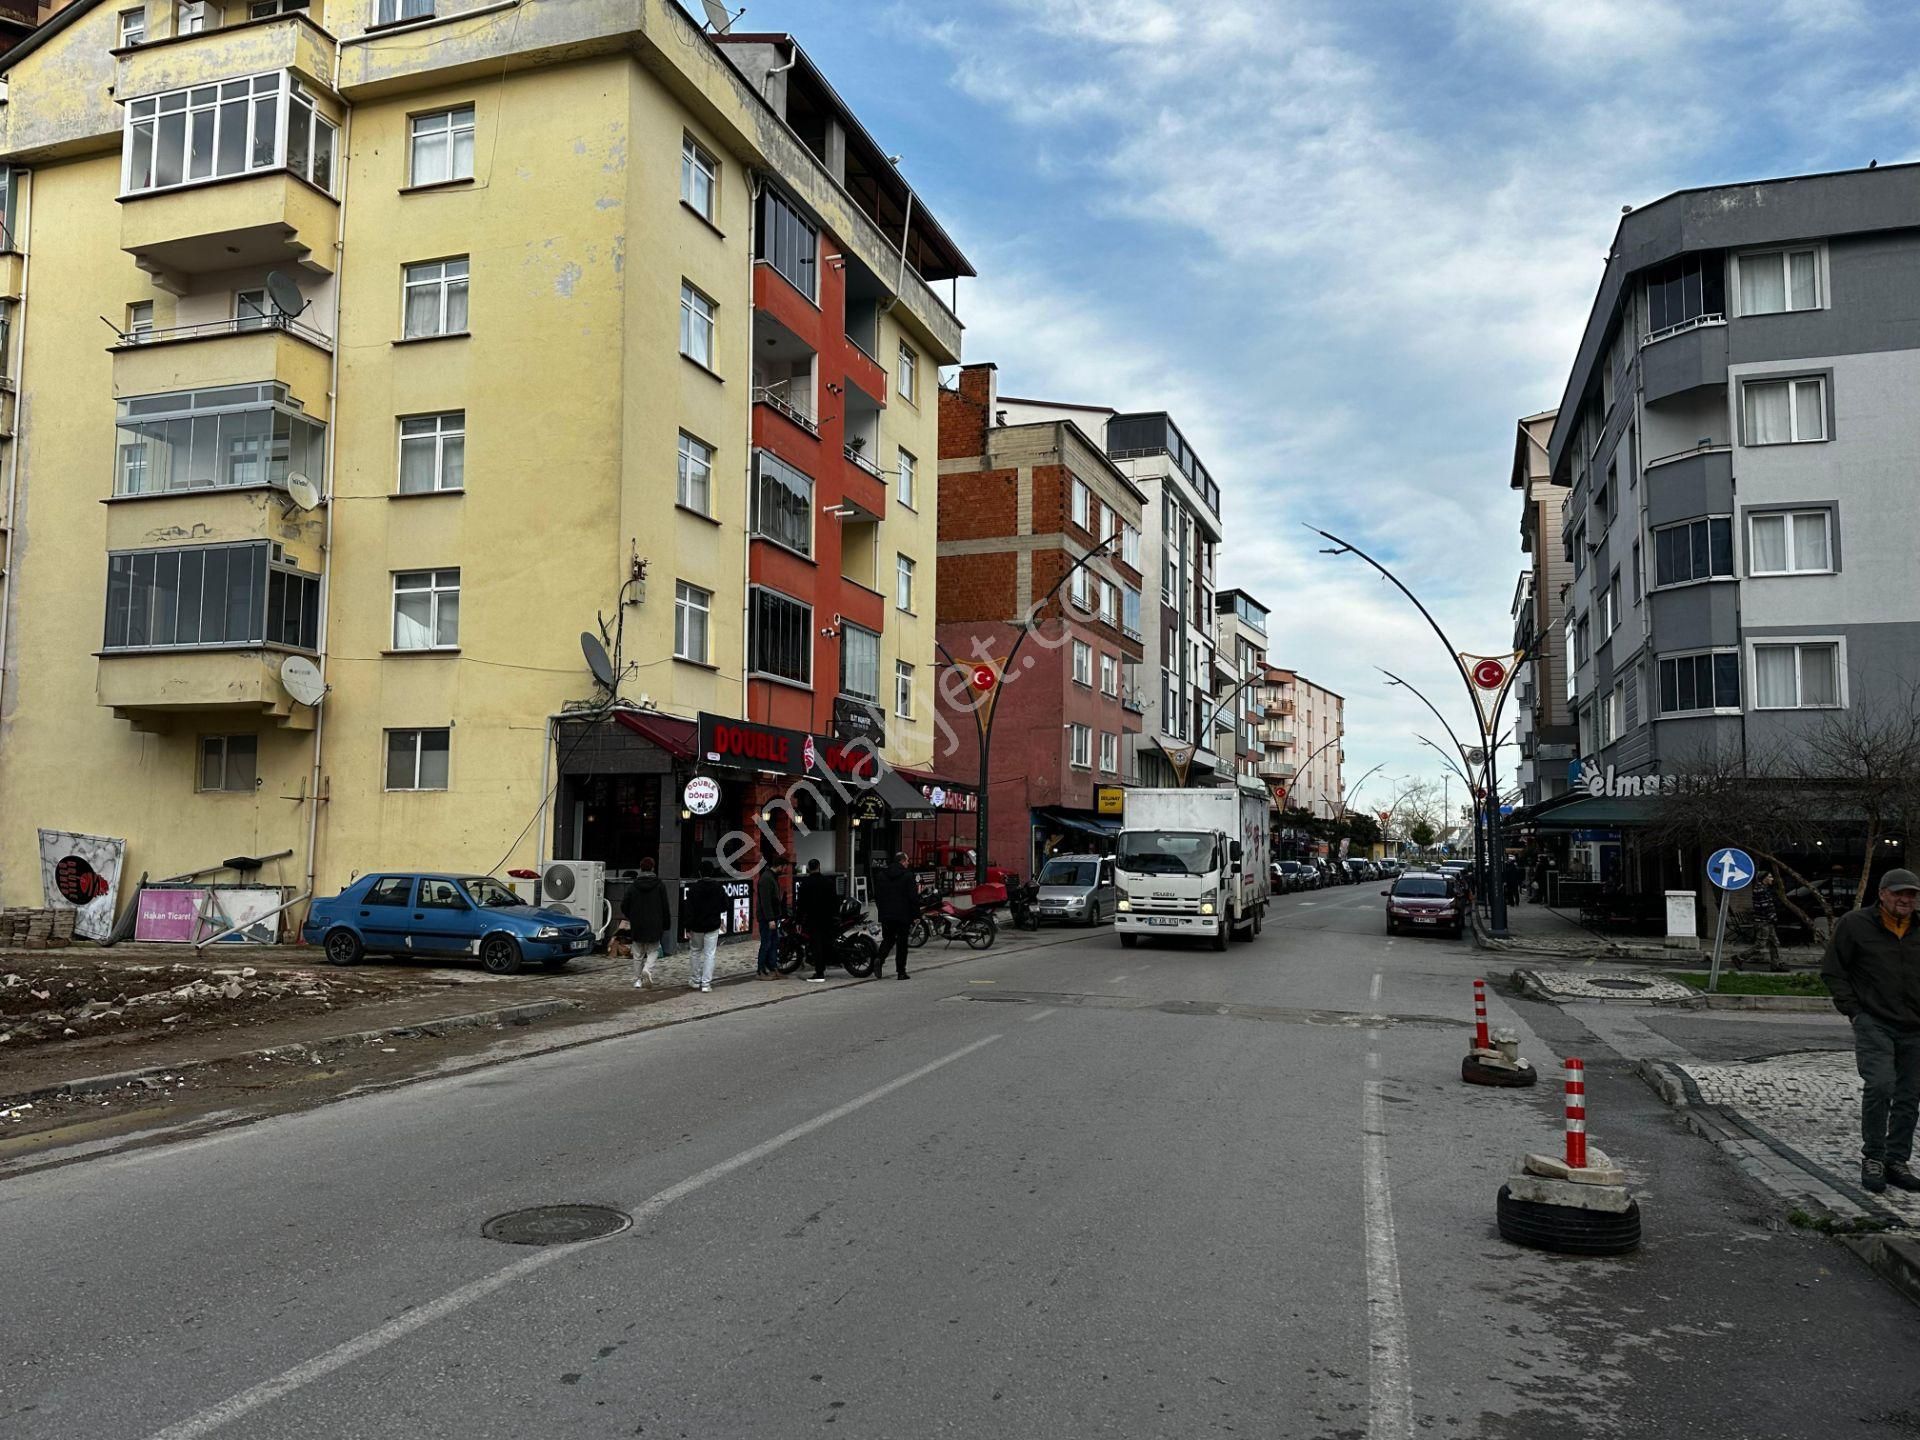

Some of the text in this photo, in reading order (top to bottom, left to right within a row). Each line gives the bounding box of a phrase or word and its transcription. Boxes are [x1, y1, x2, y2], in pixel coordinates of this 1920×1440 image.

[716, 726, 789, 763] DOUBLE
[688, 780, 716, 791] DOUBLE
[688, 791, 714, 799] DÖNER
[143, 911, 191, 921] Hakan Ticaret
